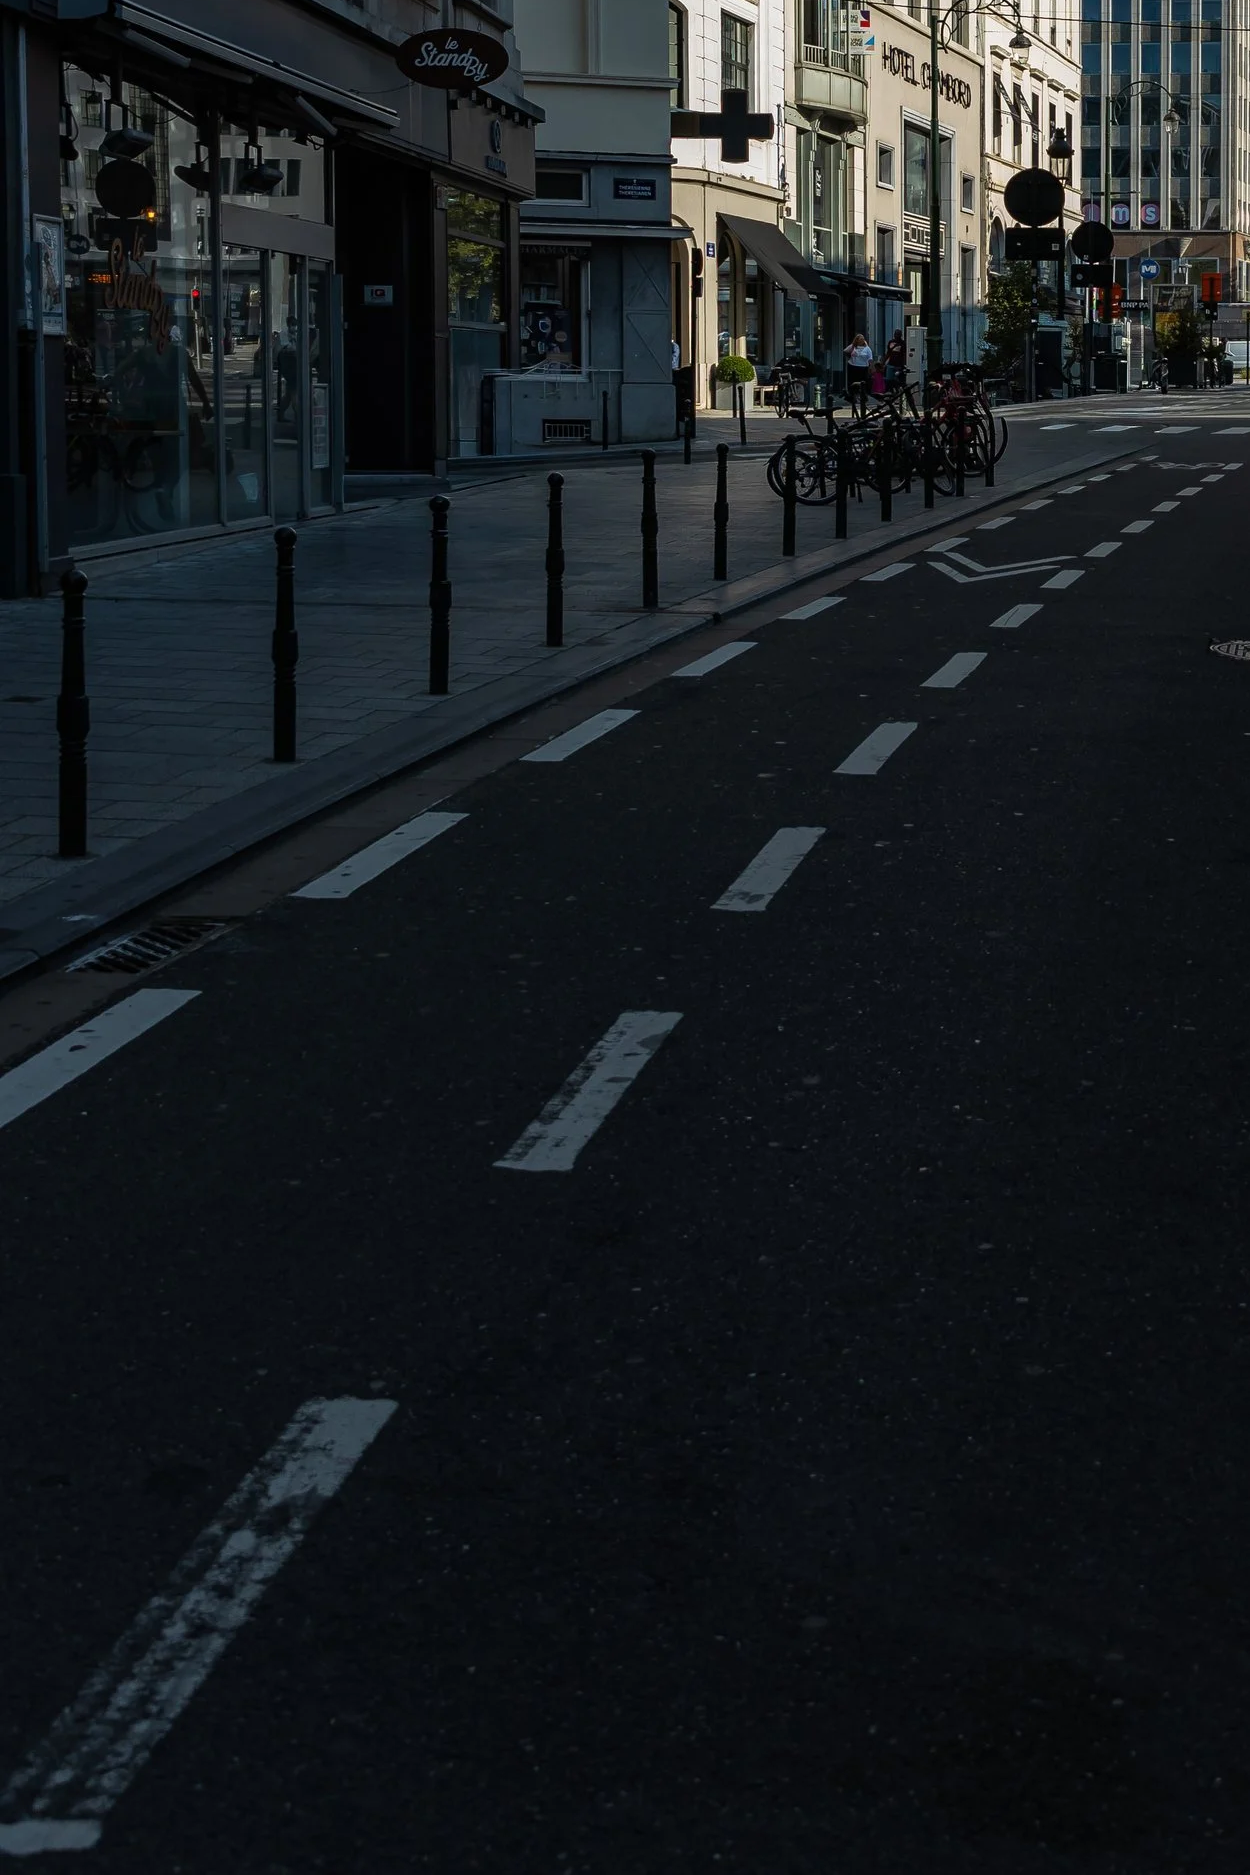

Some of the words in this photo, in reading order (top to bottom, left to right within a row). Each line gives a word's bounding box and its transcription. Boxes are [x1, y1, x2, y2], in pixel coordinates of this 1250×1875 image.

[444, 36, 459, 51] le
[882, 41, 920, 86] HOTEL
[921, 62, 972, 109] CHMBORD
[903, 222, 931, 245] HOTE
[1120, 301, 1138, 310] BNP
